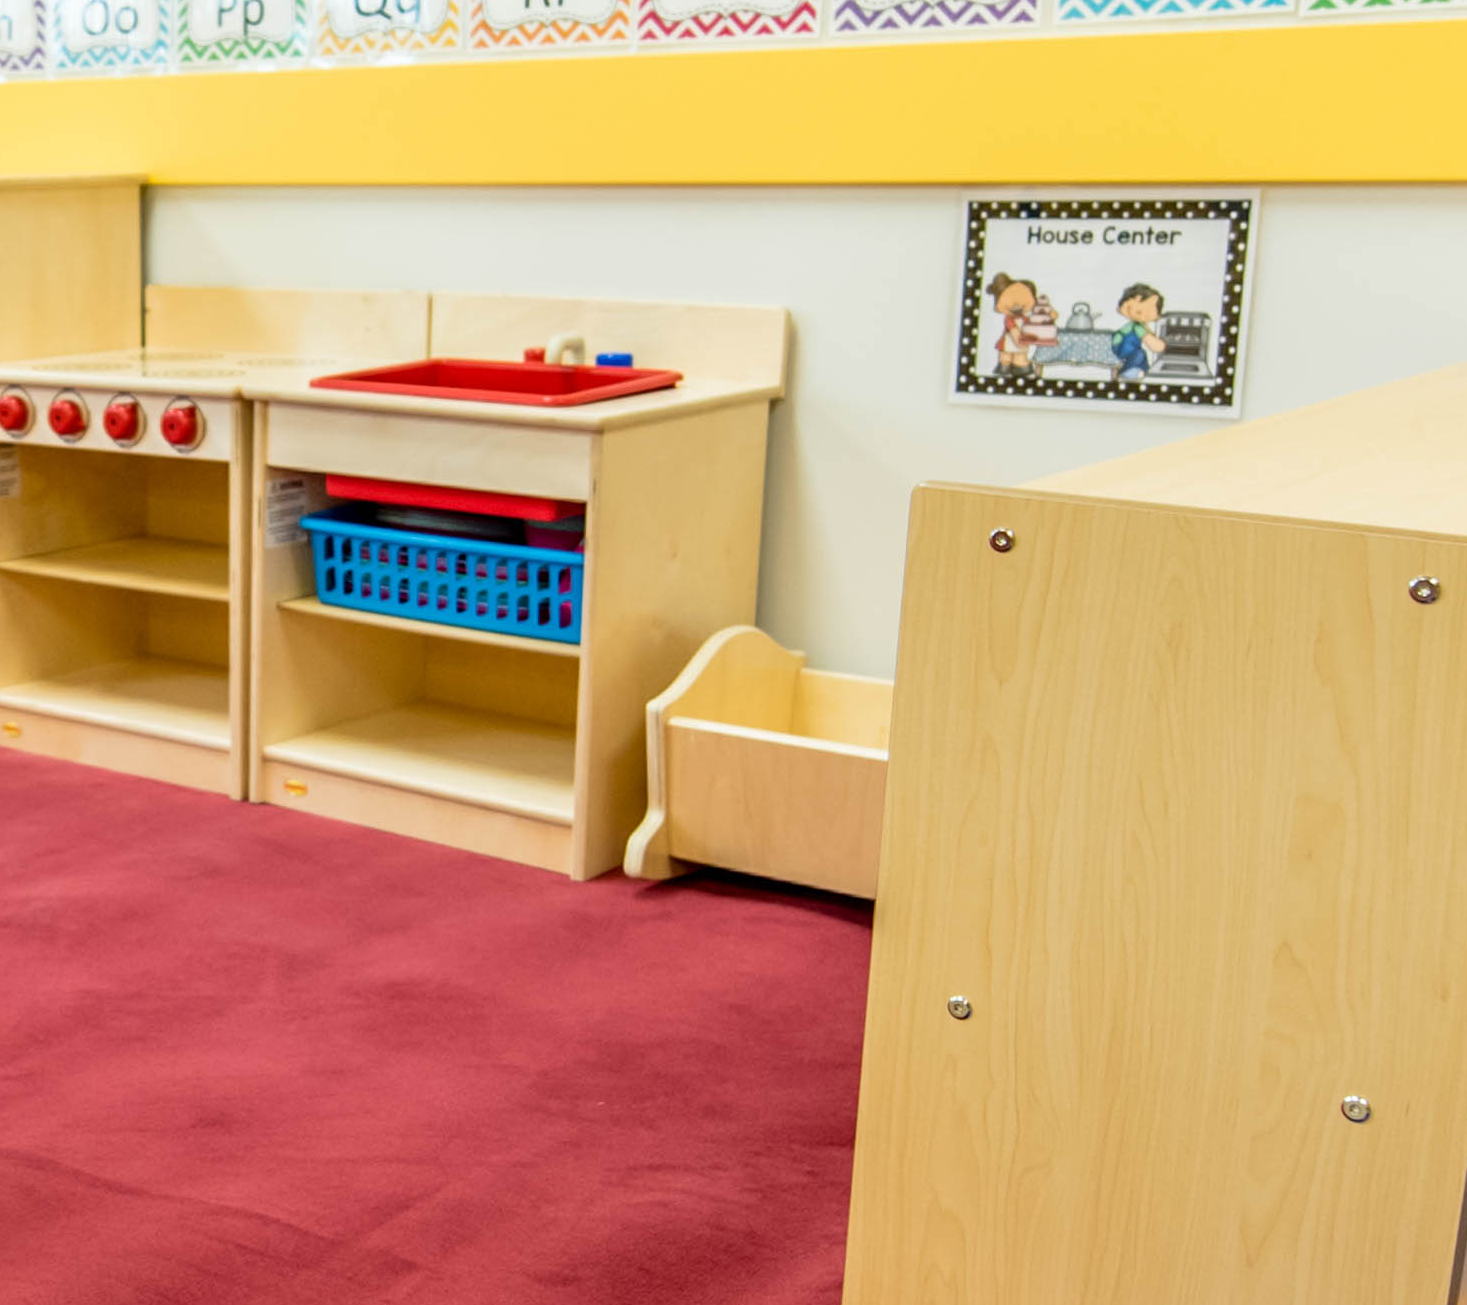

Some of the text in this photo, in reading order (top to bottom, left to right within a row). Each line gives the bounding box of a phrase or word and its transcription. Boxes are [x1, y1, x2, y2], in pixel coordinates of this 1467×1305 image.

[84, 0, 139, 35] Oo
[1027, 225, 1182, 246] House Center
